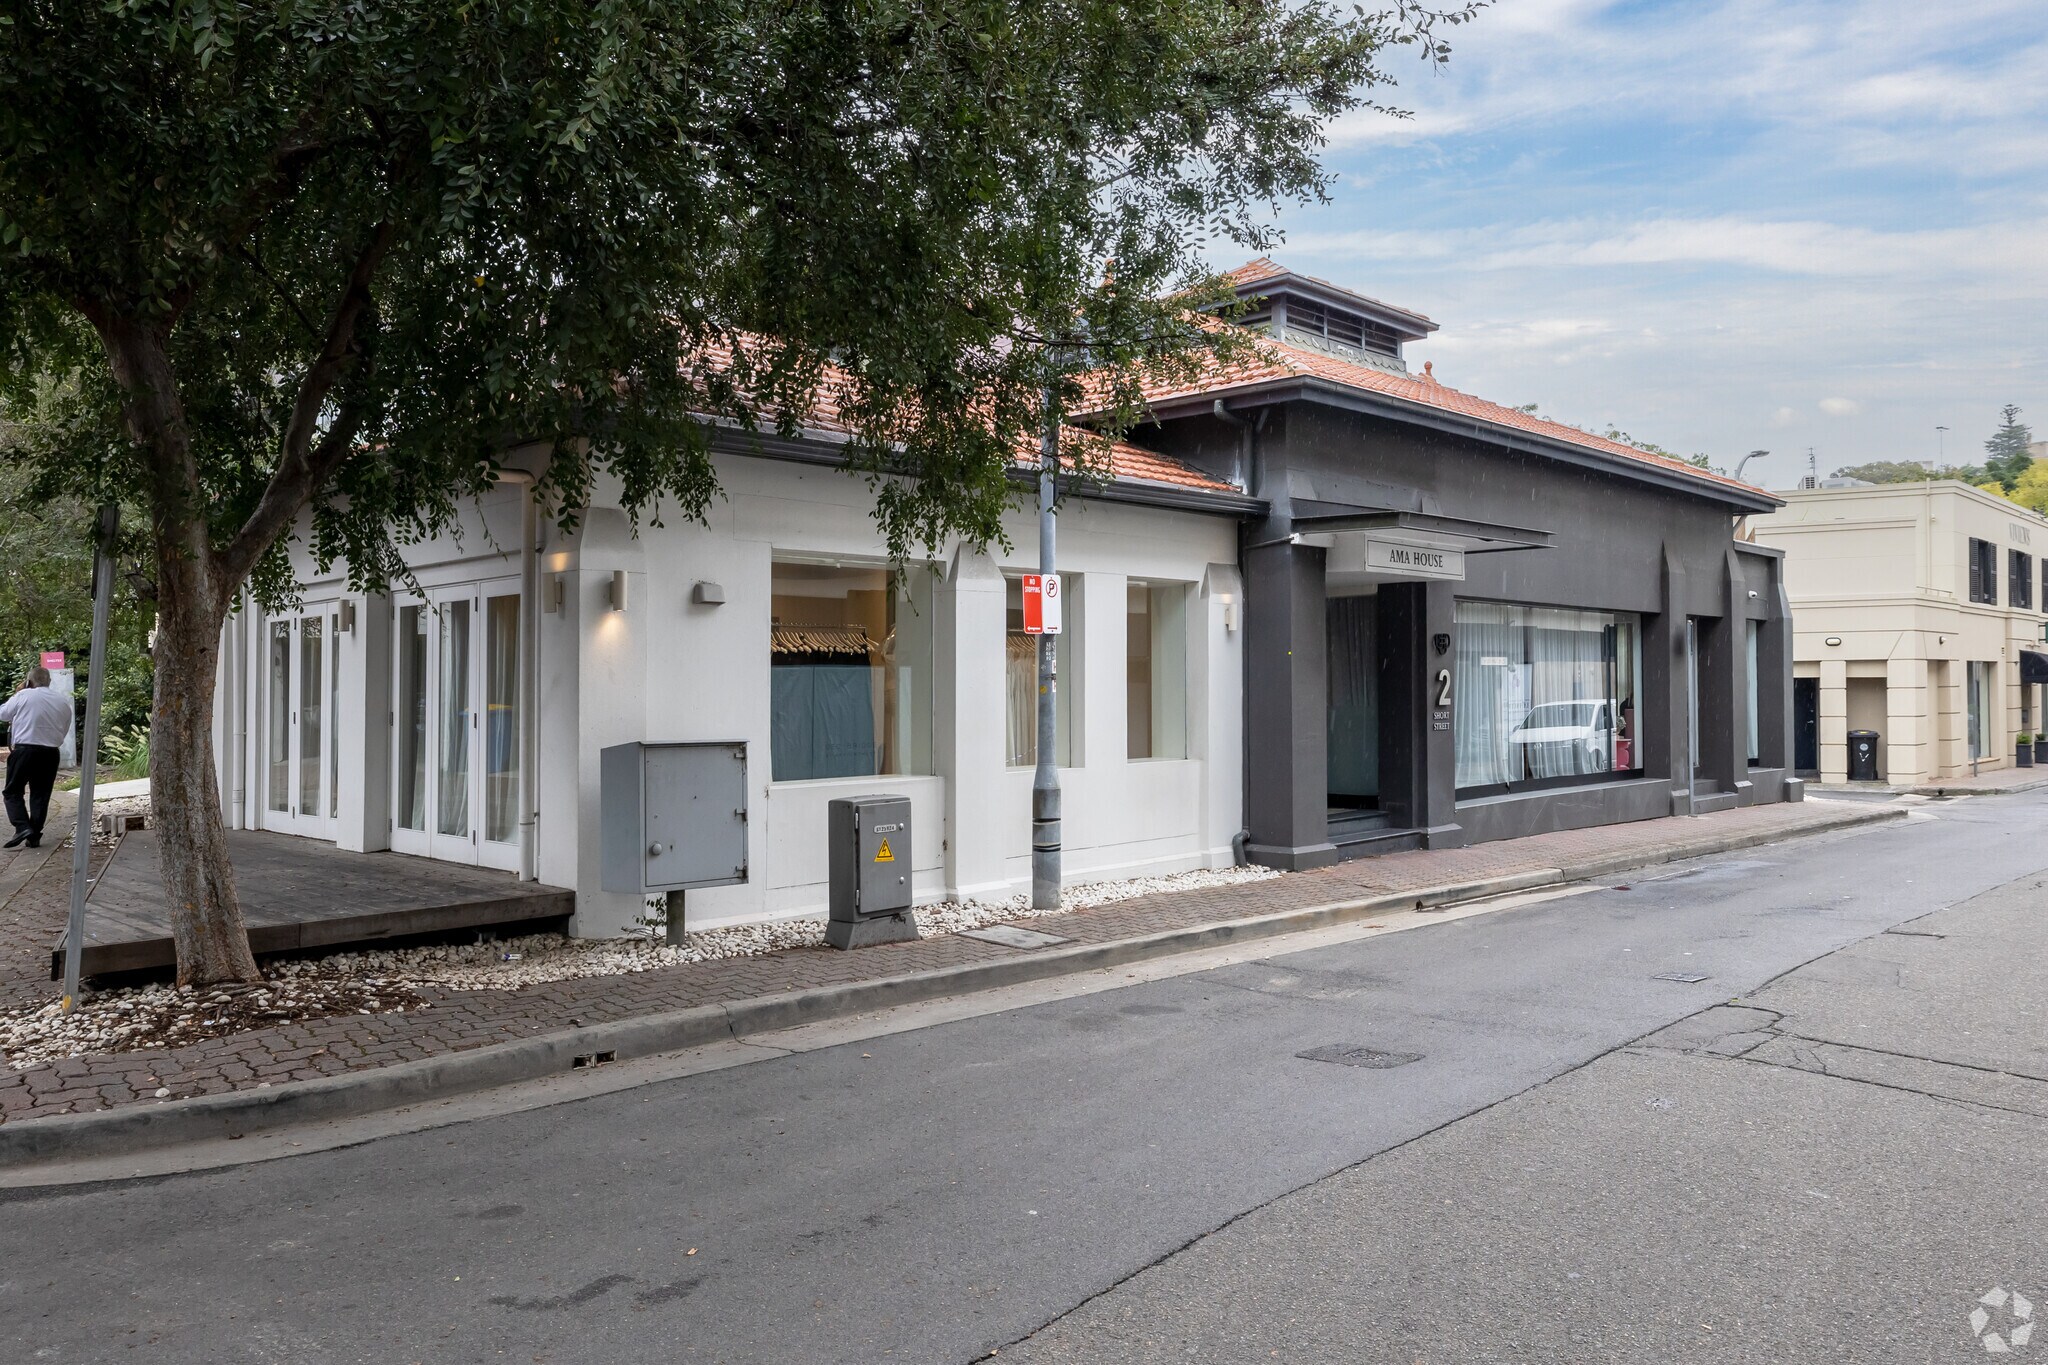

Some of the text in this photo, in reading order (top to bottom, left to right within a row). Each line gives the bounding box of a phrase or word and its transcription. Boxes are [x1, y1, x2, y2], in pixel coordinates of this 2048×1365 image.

[1389, 549, 1443, 568] AMA HOUSE
[1438, 669, 1451, 706] 2
[1433, 711, 1450, 719] SHORT
[1433, 722, 1450, 730] STREET
